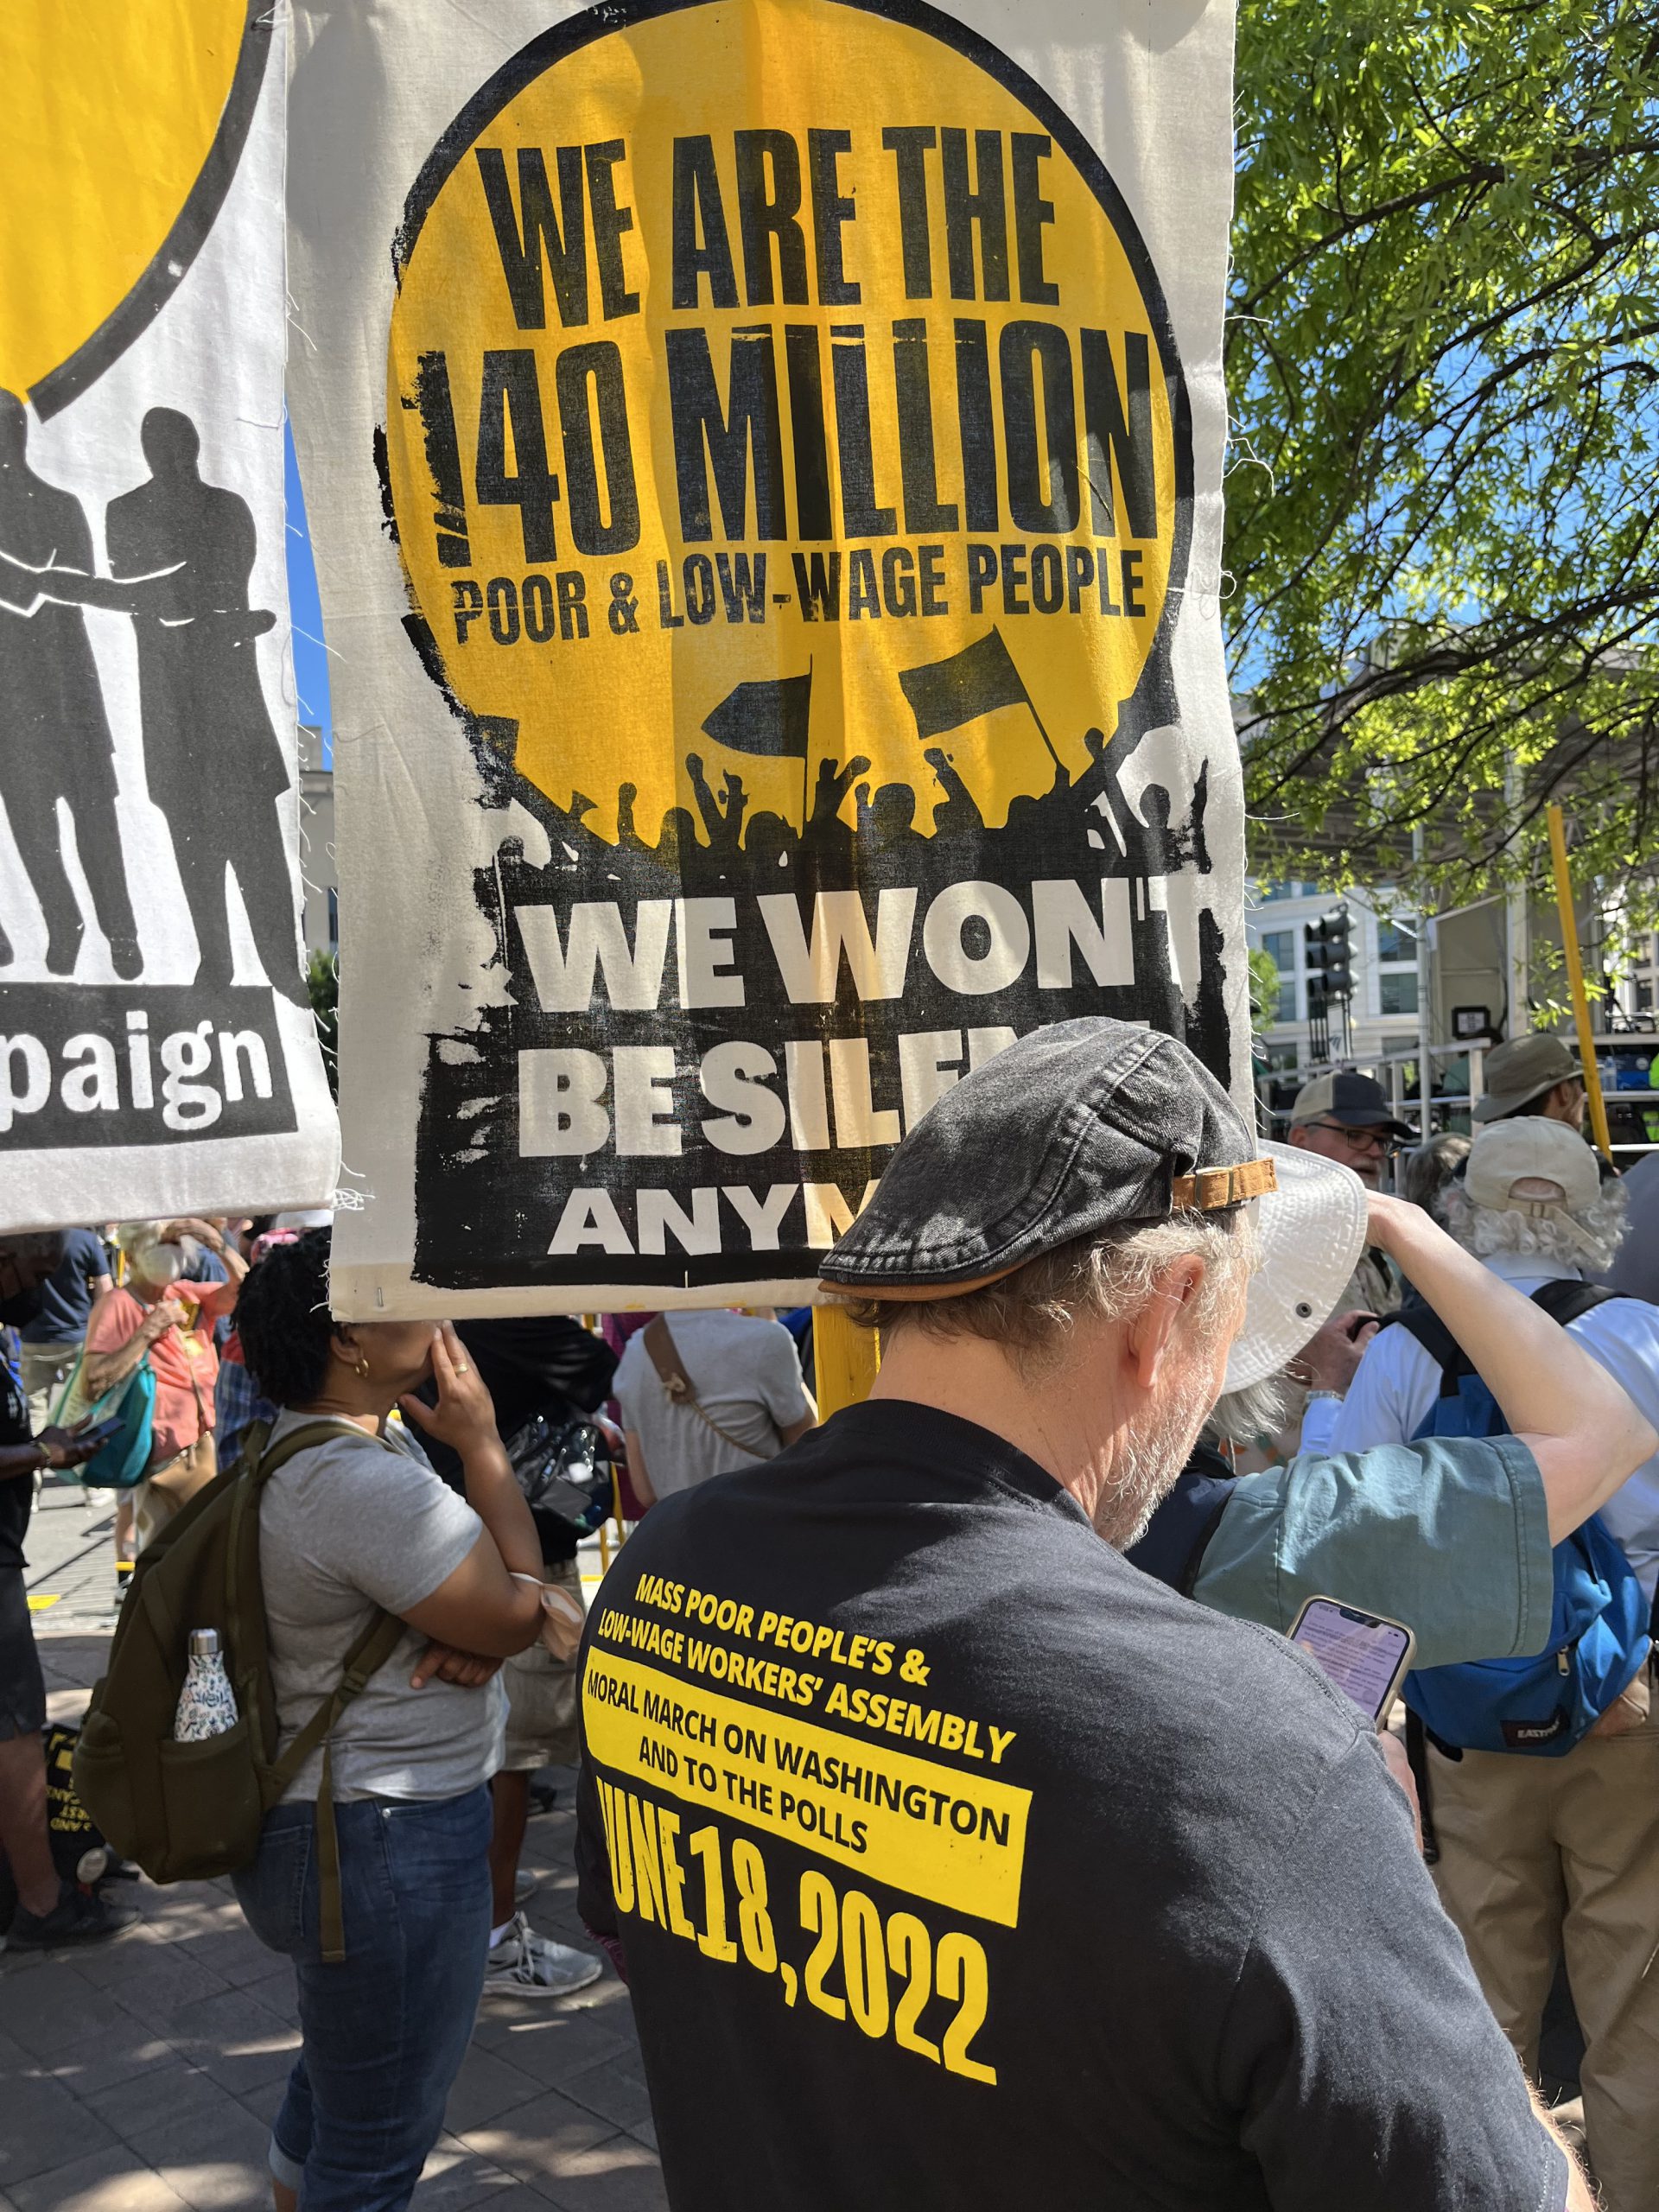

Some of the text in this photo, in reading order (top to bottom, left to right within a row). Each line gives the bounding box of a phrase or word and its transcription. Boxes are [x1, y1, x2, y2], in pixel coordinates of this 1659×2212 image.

[476, 126, 1060, 329] WE ARE THE
[664, 318, 1158, 543] MILLION
[450, 542, 1146, 645] POOR & LOW-WAGE PEOPLE
[515, 876, 1210, 1013] WE WON'T
[0, 1010, 273, 1131] paign
[518, 1020, 1150, 1157] BE SILE
[547, 1179, 880, 1255] ANYM
[598, 1608, 1017, 1764] LOW-WAGE WORKERS' ASSEMBLY
[635, 1573, 932, 1687] MASS POOR PEOPLE'S &
[588, 1669, 1010, 1847] MORAL MARCH ON WASHINGTON
[639, 1736, 868, 1853] AND TO THE POLLS
